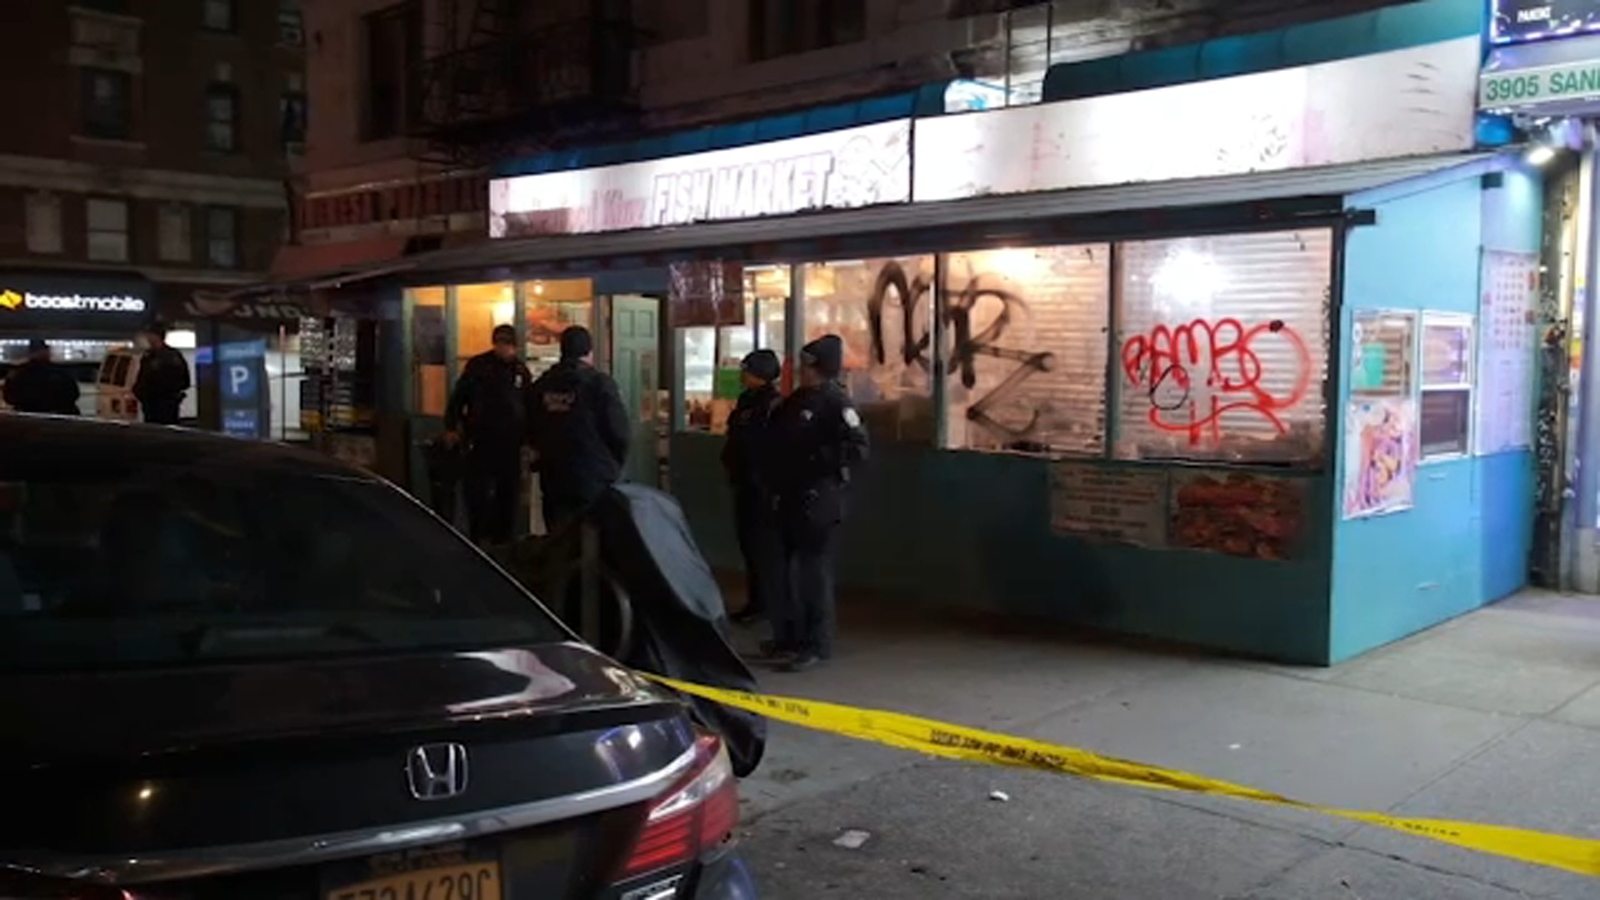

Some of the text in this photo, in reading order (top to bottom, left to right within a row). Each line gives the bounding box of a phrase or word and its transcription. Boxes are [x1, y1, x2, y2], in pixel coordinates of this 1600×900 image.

[1486, 67, 1600, 101] 3905 SAN
[654, 166, 714, 225] FISH
[714, 150, 836, 219] MARKET
[229, 364, 250, 395] P
